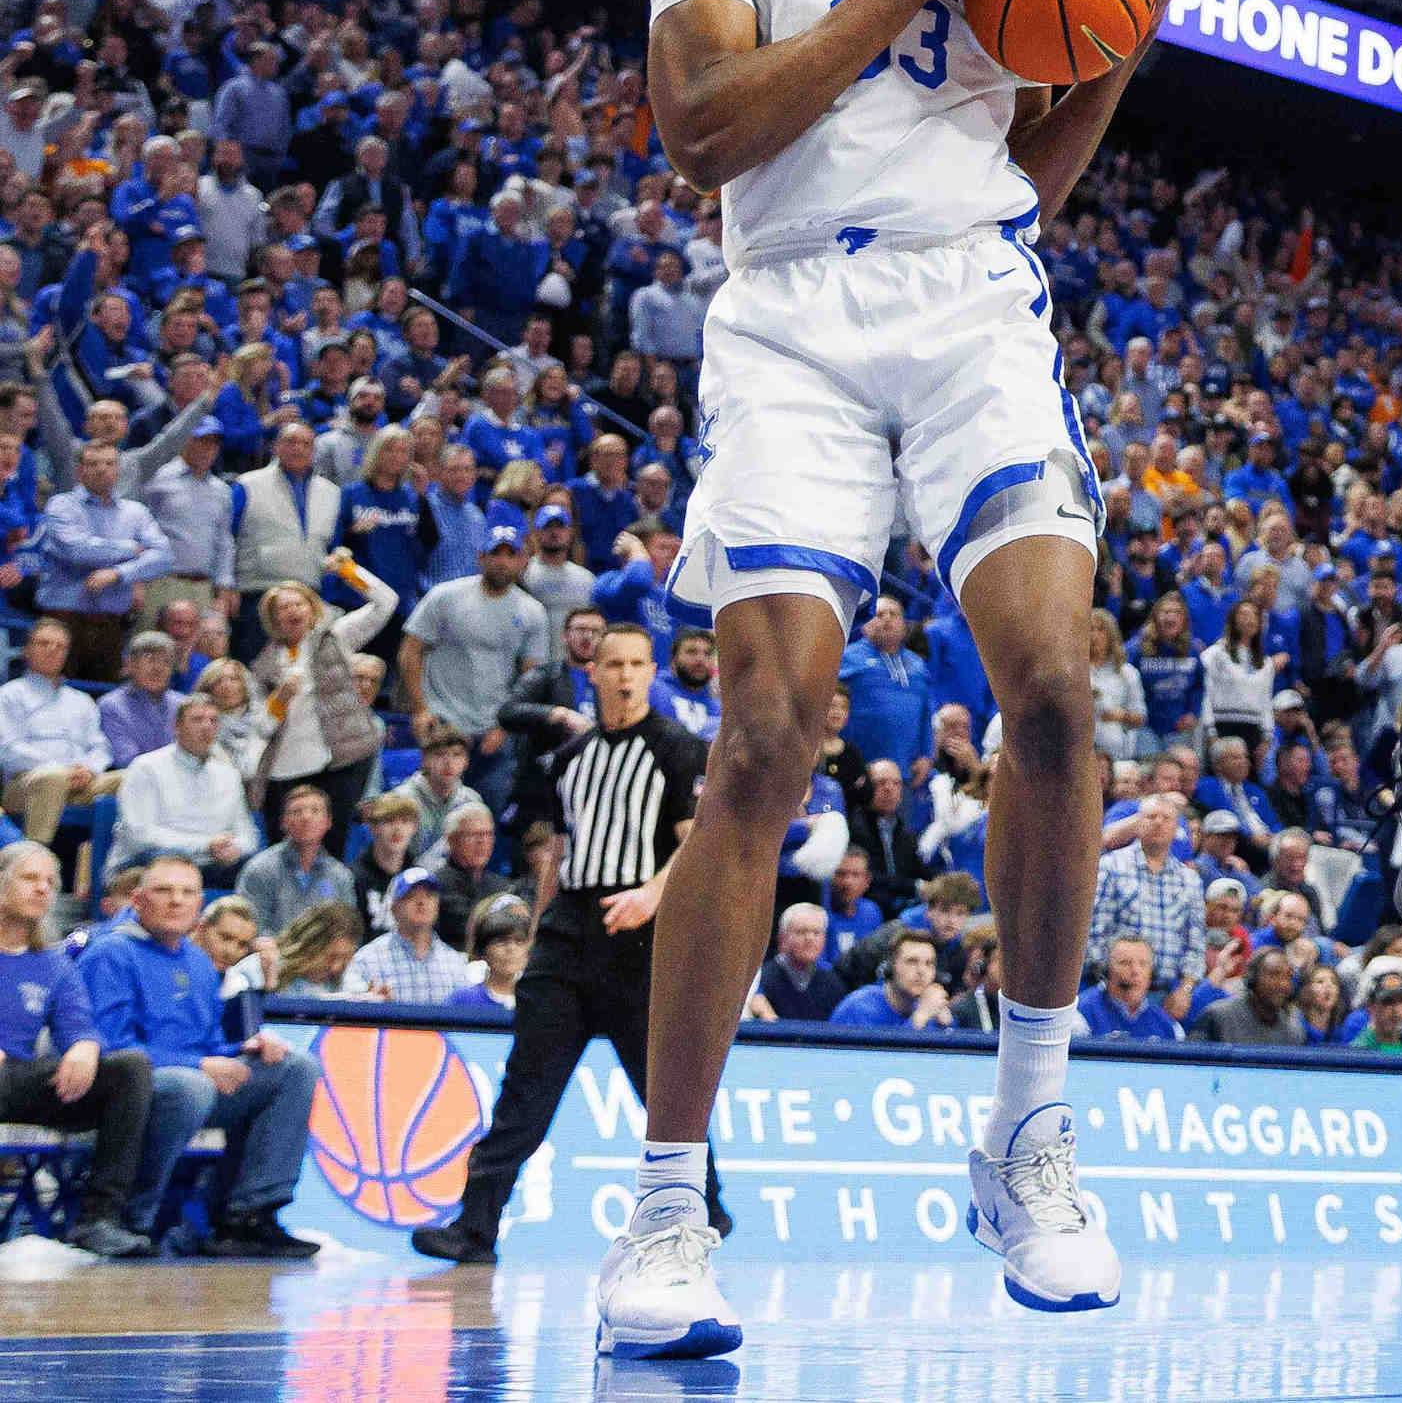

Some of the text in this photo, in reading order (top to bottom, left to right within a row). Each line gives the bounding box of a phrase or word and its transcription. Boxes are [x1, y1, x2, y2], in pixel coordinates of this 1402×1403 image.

[576, 1064, 1389, 1160] WITE GRE MAGGARD
